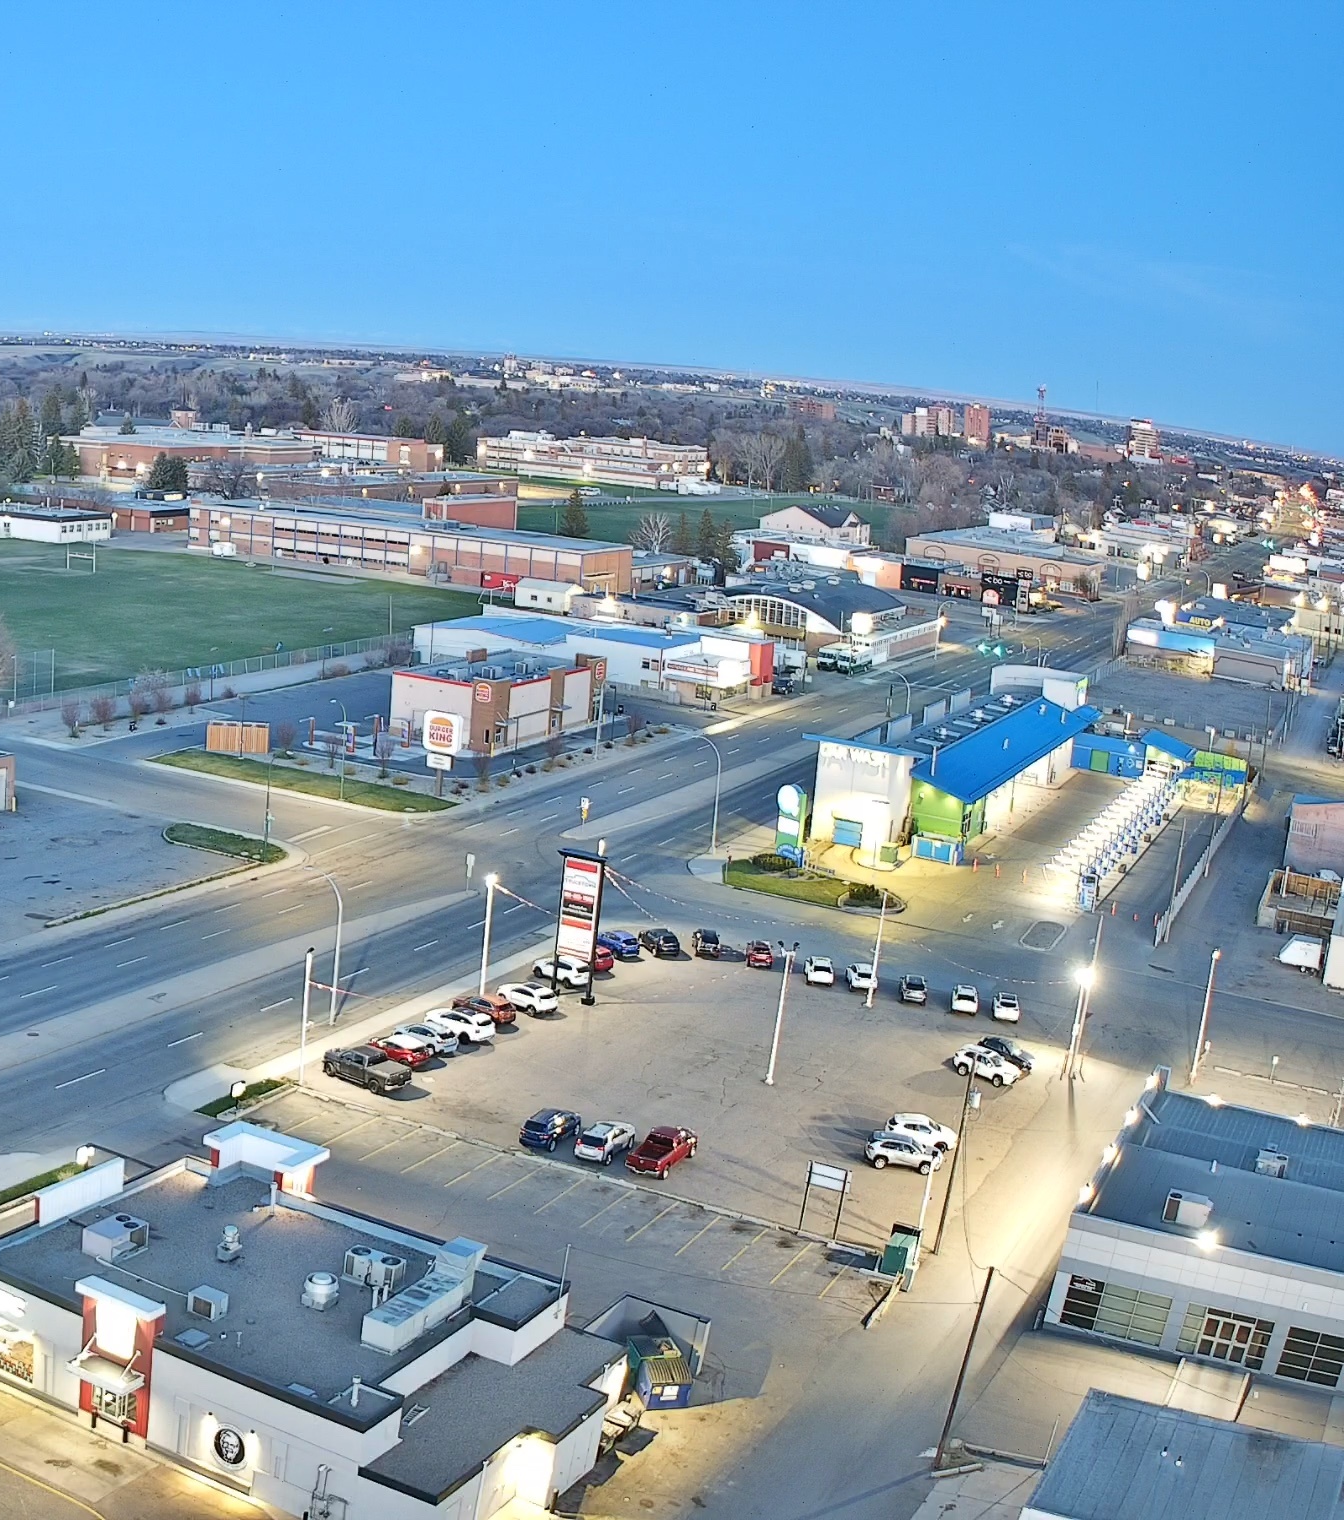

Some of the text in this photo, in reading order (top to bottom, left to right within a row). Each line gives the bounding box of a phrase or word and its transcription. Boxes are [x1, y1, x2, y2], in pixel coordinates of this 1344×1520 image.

[1188, 615, 1212, 627] AUTO
[429, 724, 454, 734] BURGER
[428, 731, 453, 743] KING
